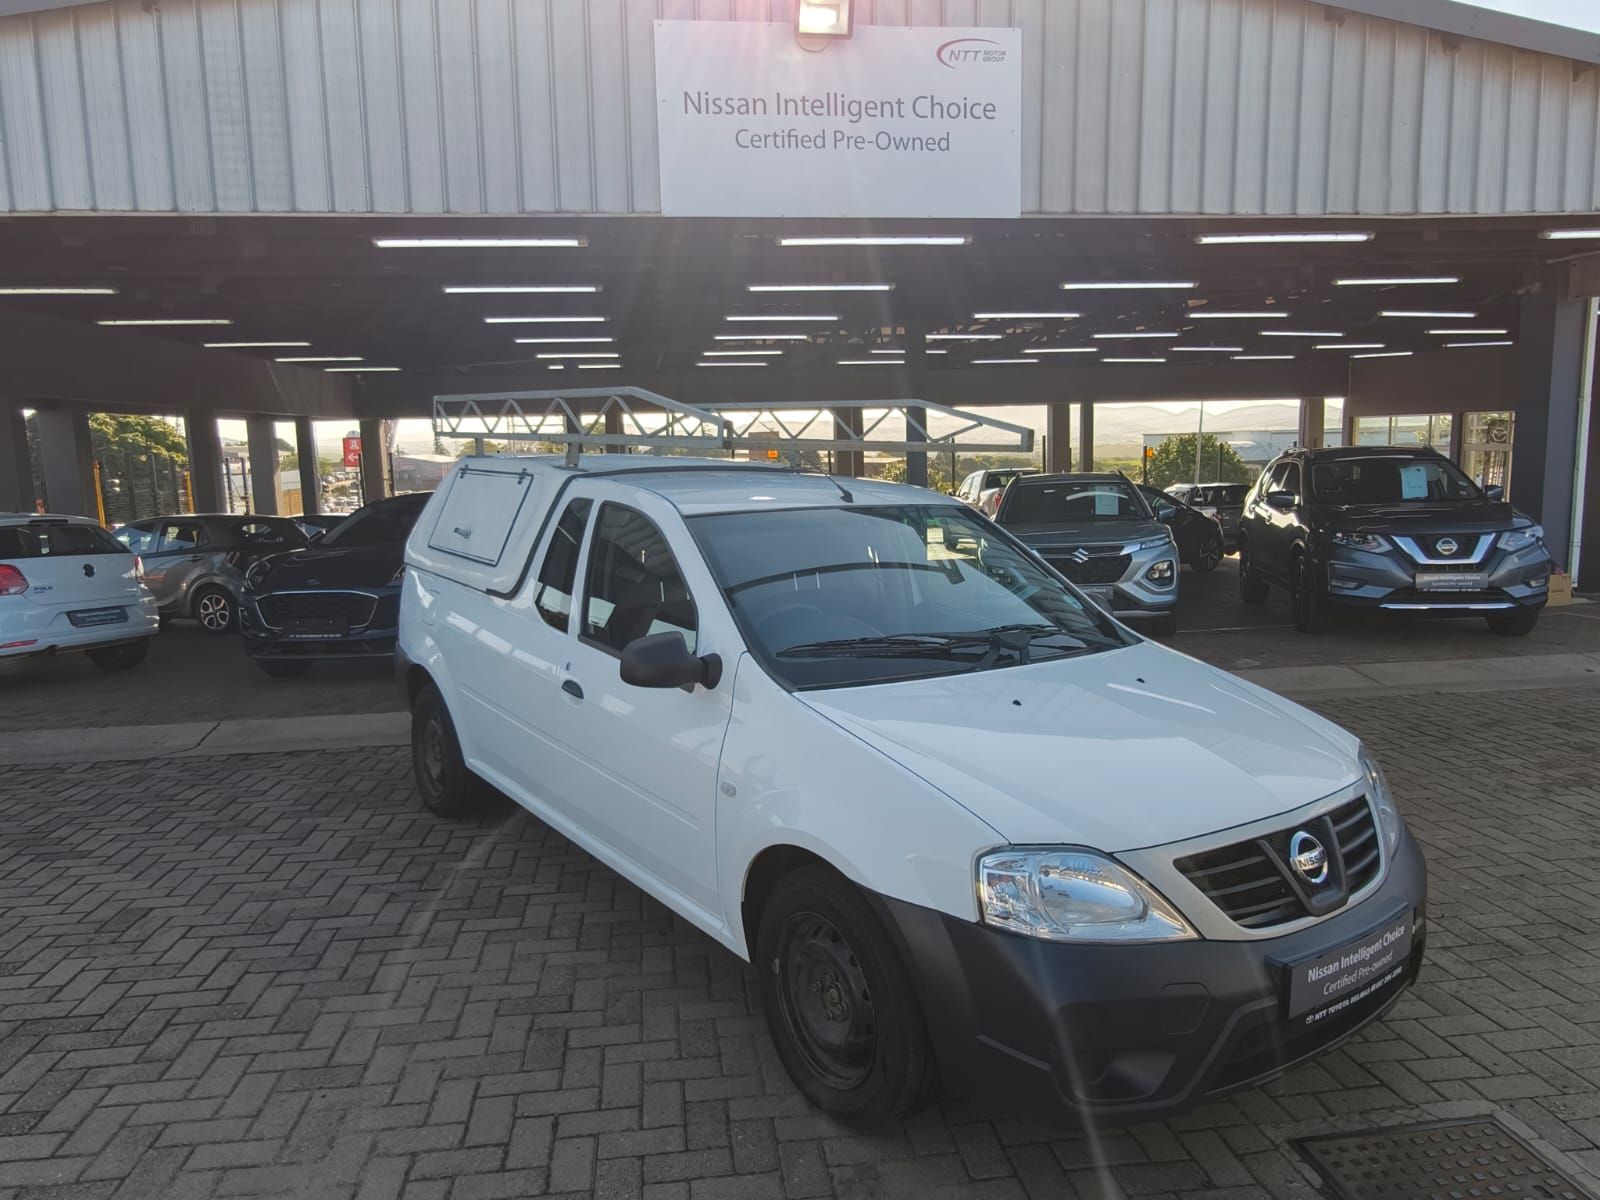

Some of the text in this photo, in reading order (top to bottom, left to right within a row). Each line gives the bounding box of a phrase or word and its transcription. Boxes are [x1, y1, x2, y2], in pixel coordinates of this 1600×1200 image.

[948, 49, 982, 62] NTT
[683, 91, 997, 123] Nissan Intelligent Choice
[735, 128, 950, 152] Certified Pre-Owned
[1308, 926, 1405, 983] Nissan Intelligent Choice
[1323, 970, 1358, 995] Certified
[1358, 949, 1393, 979] Pre-owned
